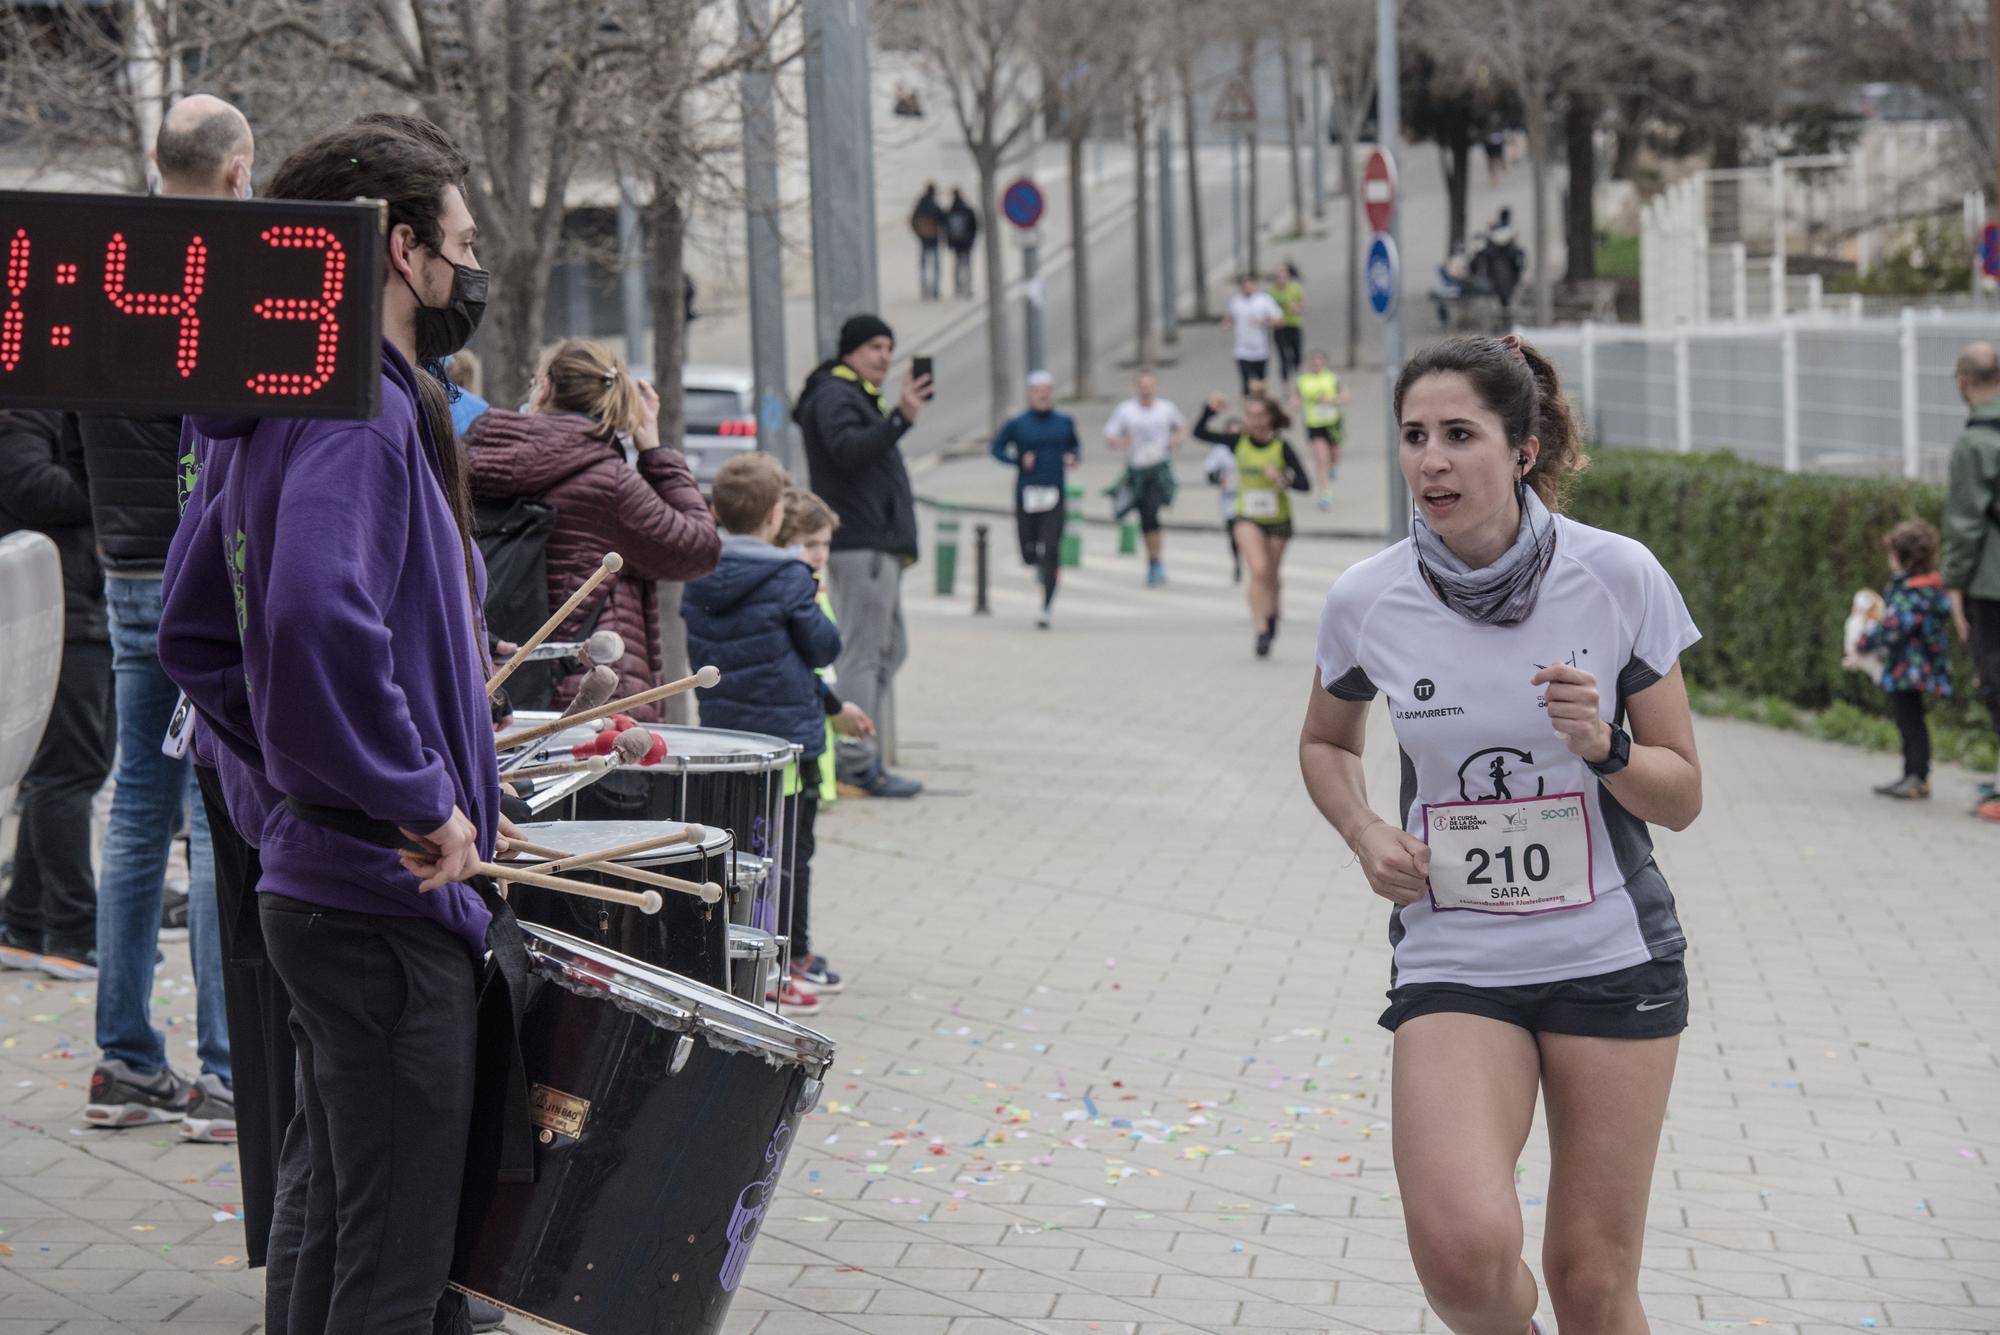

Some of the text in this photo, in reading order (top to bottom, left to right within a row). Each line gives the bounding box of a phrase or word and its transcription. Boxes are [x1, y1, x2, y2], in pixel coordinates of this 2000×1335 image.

[1396, 706, 1465, 720] LA SAMARRETTA
[1464, 843, 1551, 885] 210
[1490, 886, 1531, 899] SARA
